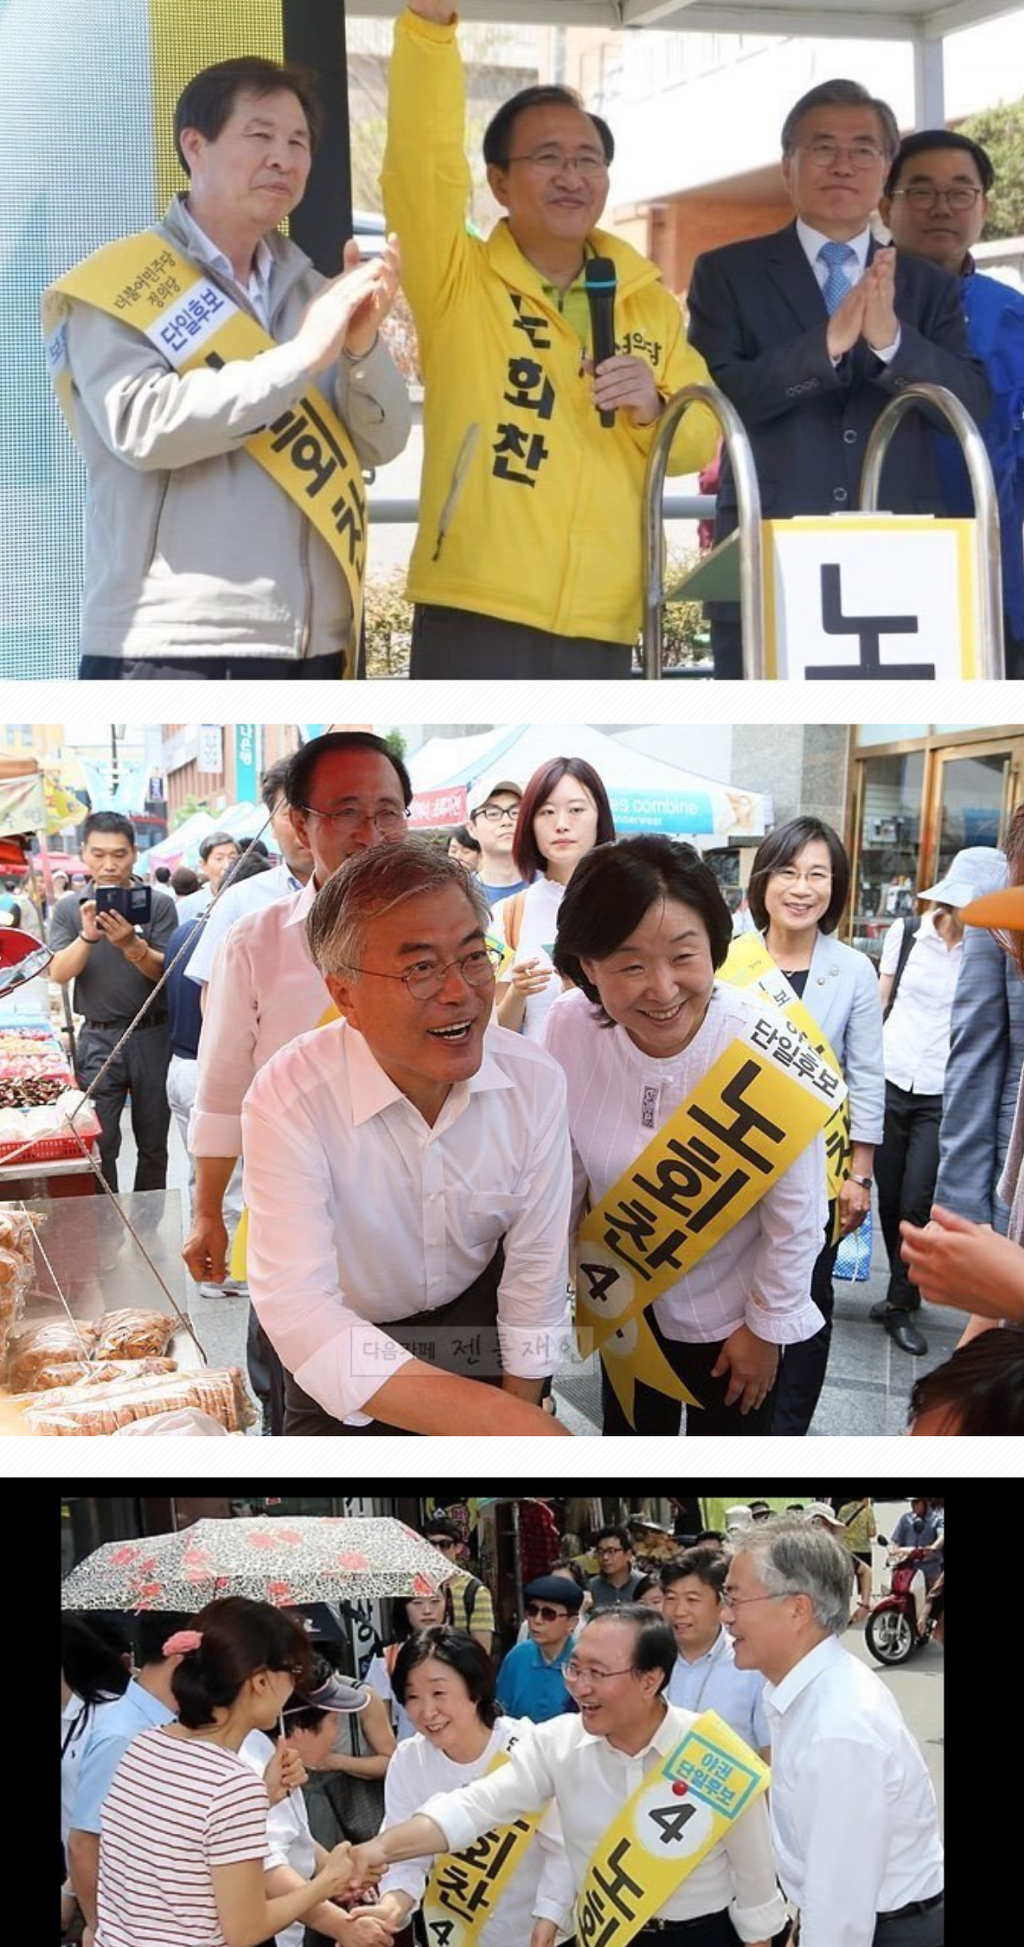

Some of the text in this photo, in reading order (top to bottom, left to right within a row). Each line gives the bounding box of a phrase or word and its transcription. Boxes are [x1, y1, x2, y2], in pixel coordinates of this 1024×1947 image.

[113, 250, 176, 310] 더불어민주당
[148, 276, 181, 308] 정의당
[160, 288, 224, 352] 단일후보
[804, 563, 936, 681] 노
[632, 798, 698, 816] combine
[750, 1018, 840, 1099] 단일후보
[603, 1059, 787, 1282] 노회찬
[579, 1263, 621, 1302] 4
[676, 1759, 737, 1808] 단일후보
[701, 1753, 734, 1783] 야권
[648, 1803, 697, 1844] 4
[437, 1819, 531, 1924] 회찬
[428, 1919, 455, 1947] 4
